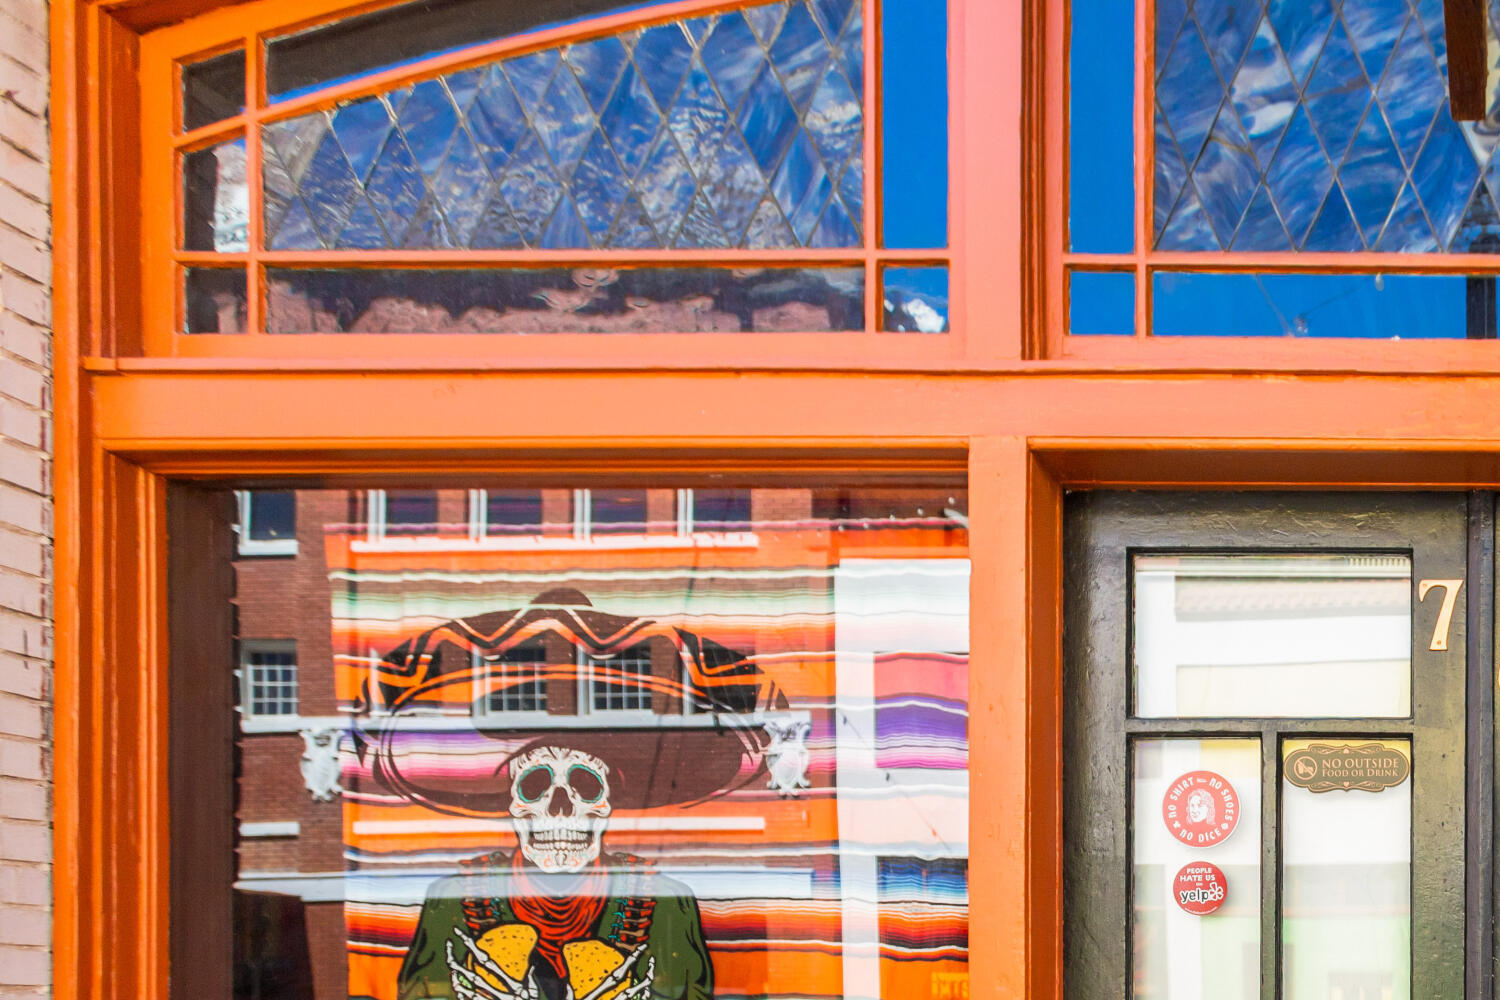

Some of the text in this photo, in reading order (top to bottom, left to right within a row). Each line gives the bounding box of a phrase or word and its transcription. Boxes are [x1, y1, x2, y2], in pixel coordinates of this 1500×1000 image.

[1418, 579, 1464, 651] 7
[1322, 758, 1399, 769] NO OUTSIDE
[1167, 776, 1194, 819] NO SHIRT
[1209, 777, 1234, 822] NO SHOES
[1179, 827, 1222, 844] NO DICE
[1180, 874, 1203, 882] HATE
[1180, 888, 1209, 903] yelp
